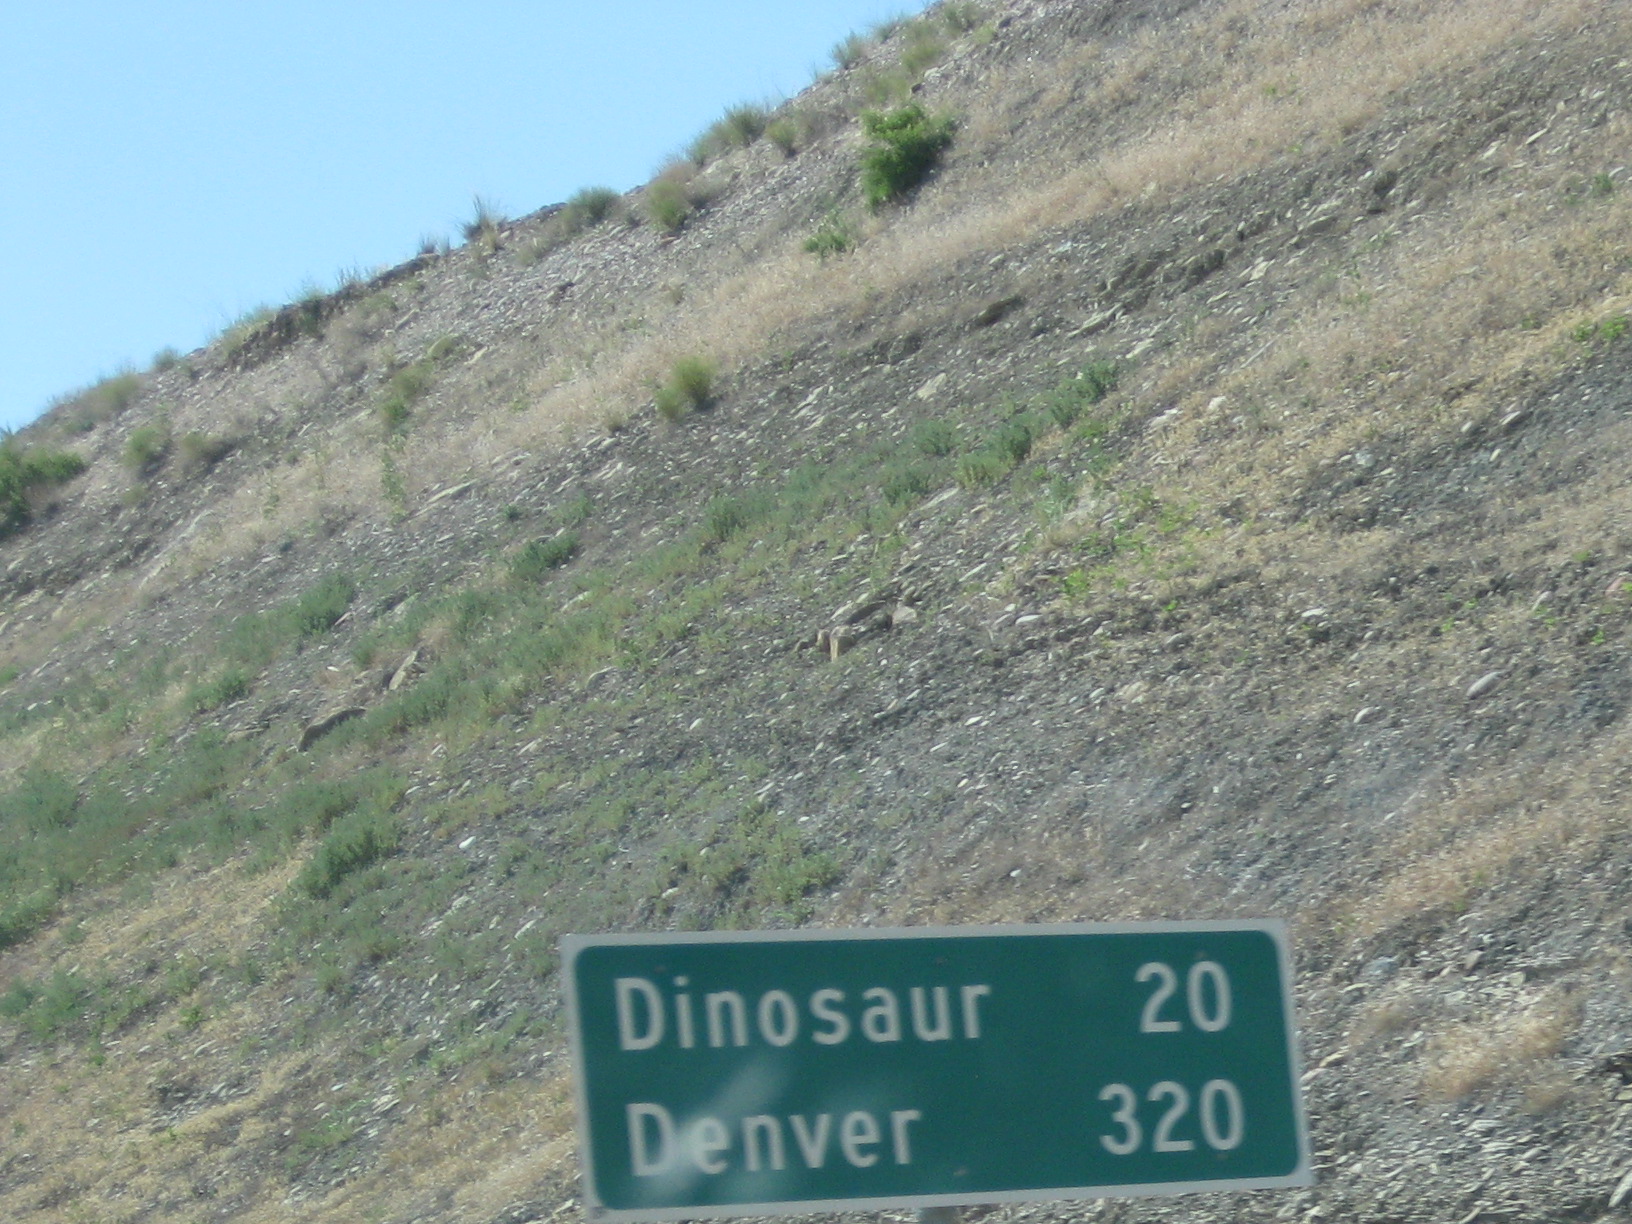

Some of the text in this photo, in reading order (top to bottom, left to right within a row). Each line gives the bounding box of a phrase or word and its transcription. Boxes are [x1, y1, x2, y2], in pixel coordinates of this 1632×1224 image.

[614, 960, 1232, 1052] Dinosaur 20
[625, 1078, 1244, 1177] Denver 320
